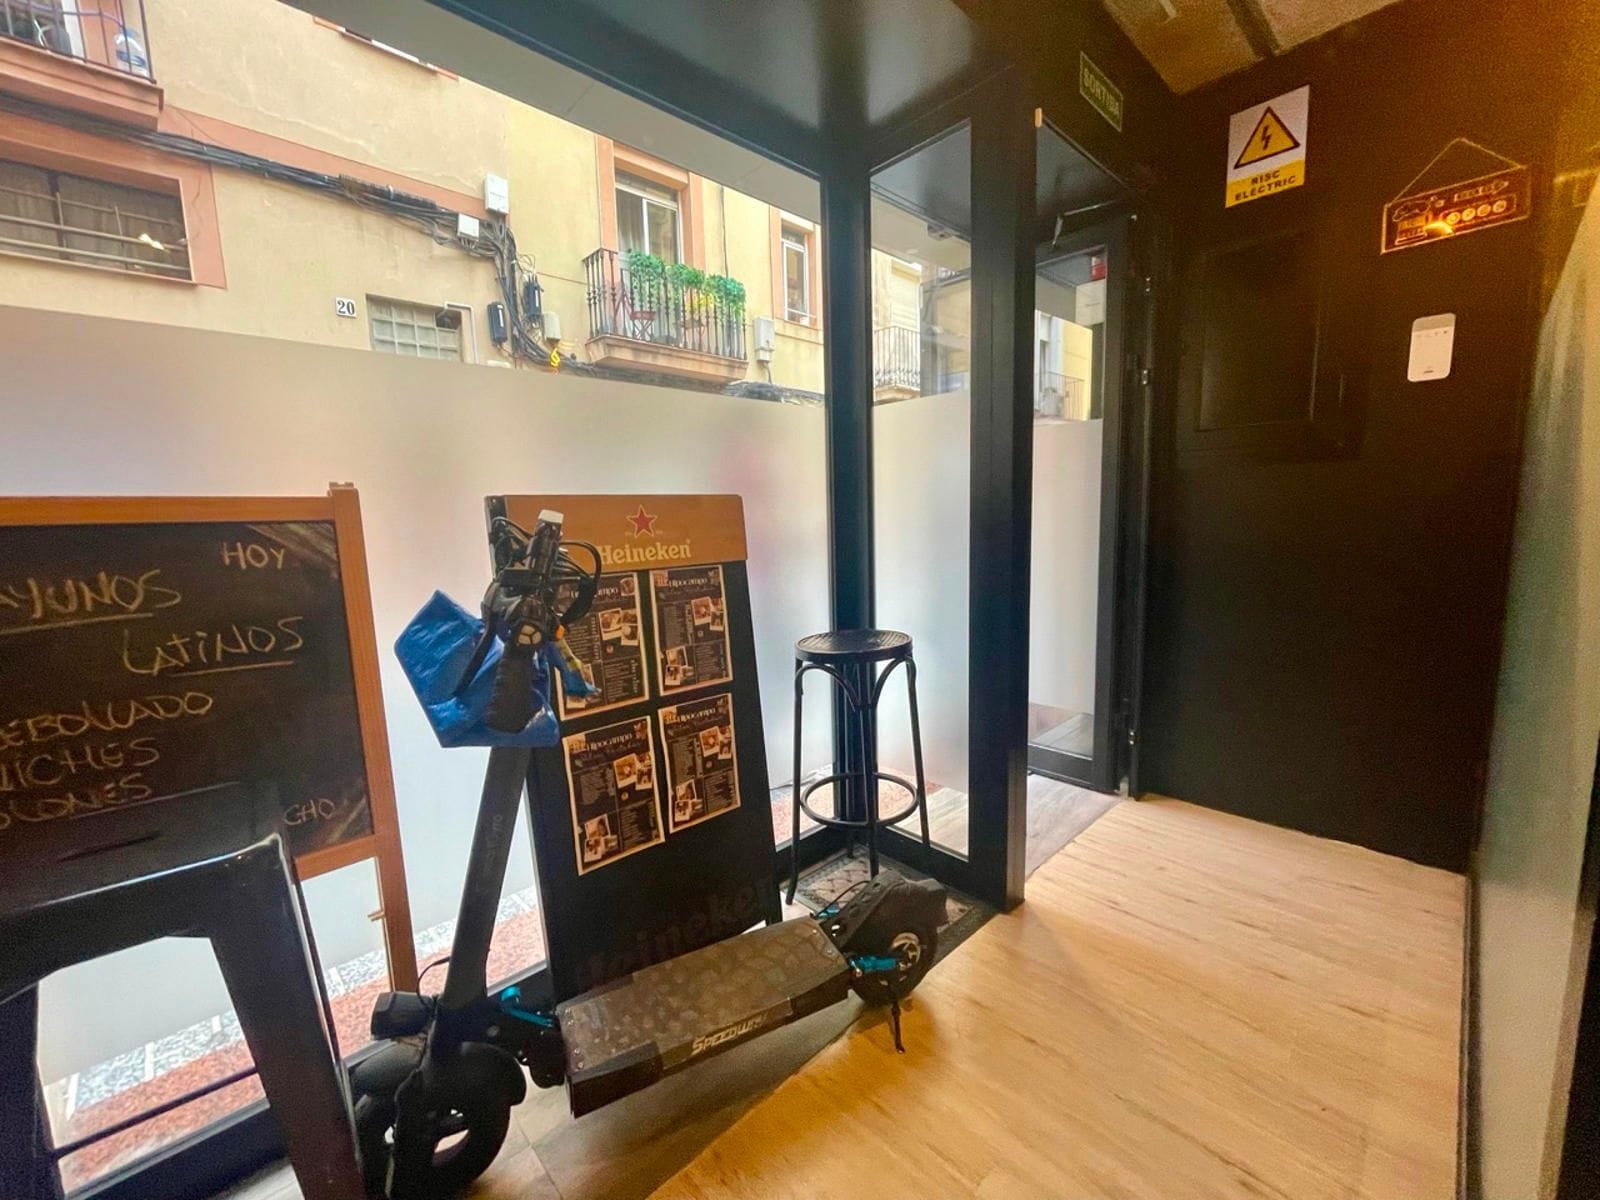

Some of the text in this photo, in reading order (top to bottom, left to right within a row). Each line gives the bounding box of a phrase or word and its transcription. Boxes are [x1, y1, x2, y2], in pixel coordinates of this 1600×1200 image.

[1251, 169, 1281, 186] RISC
[336, 299, 356, 316] 20
[222, 541, 286, 571] HOY
[596, 541, 692, 566] Heineken
